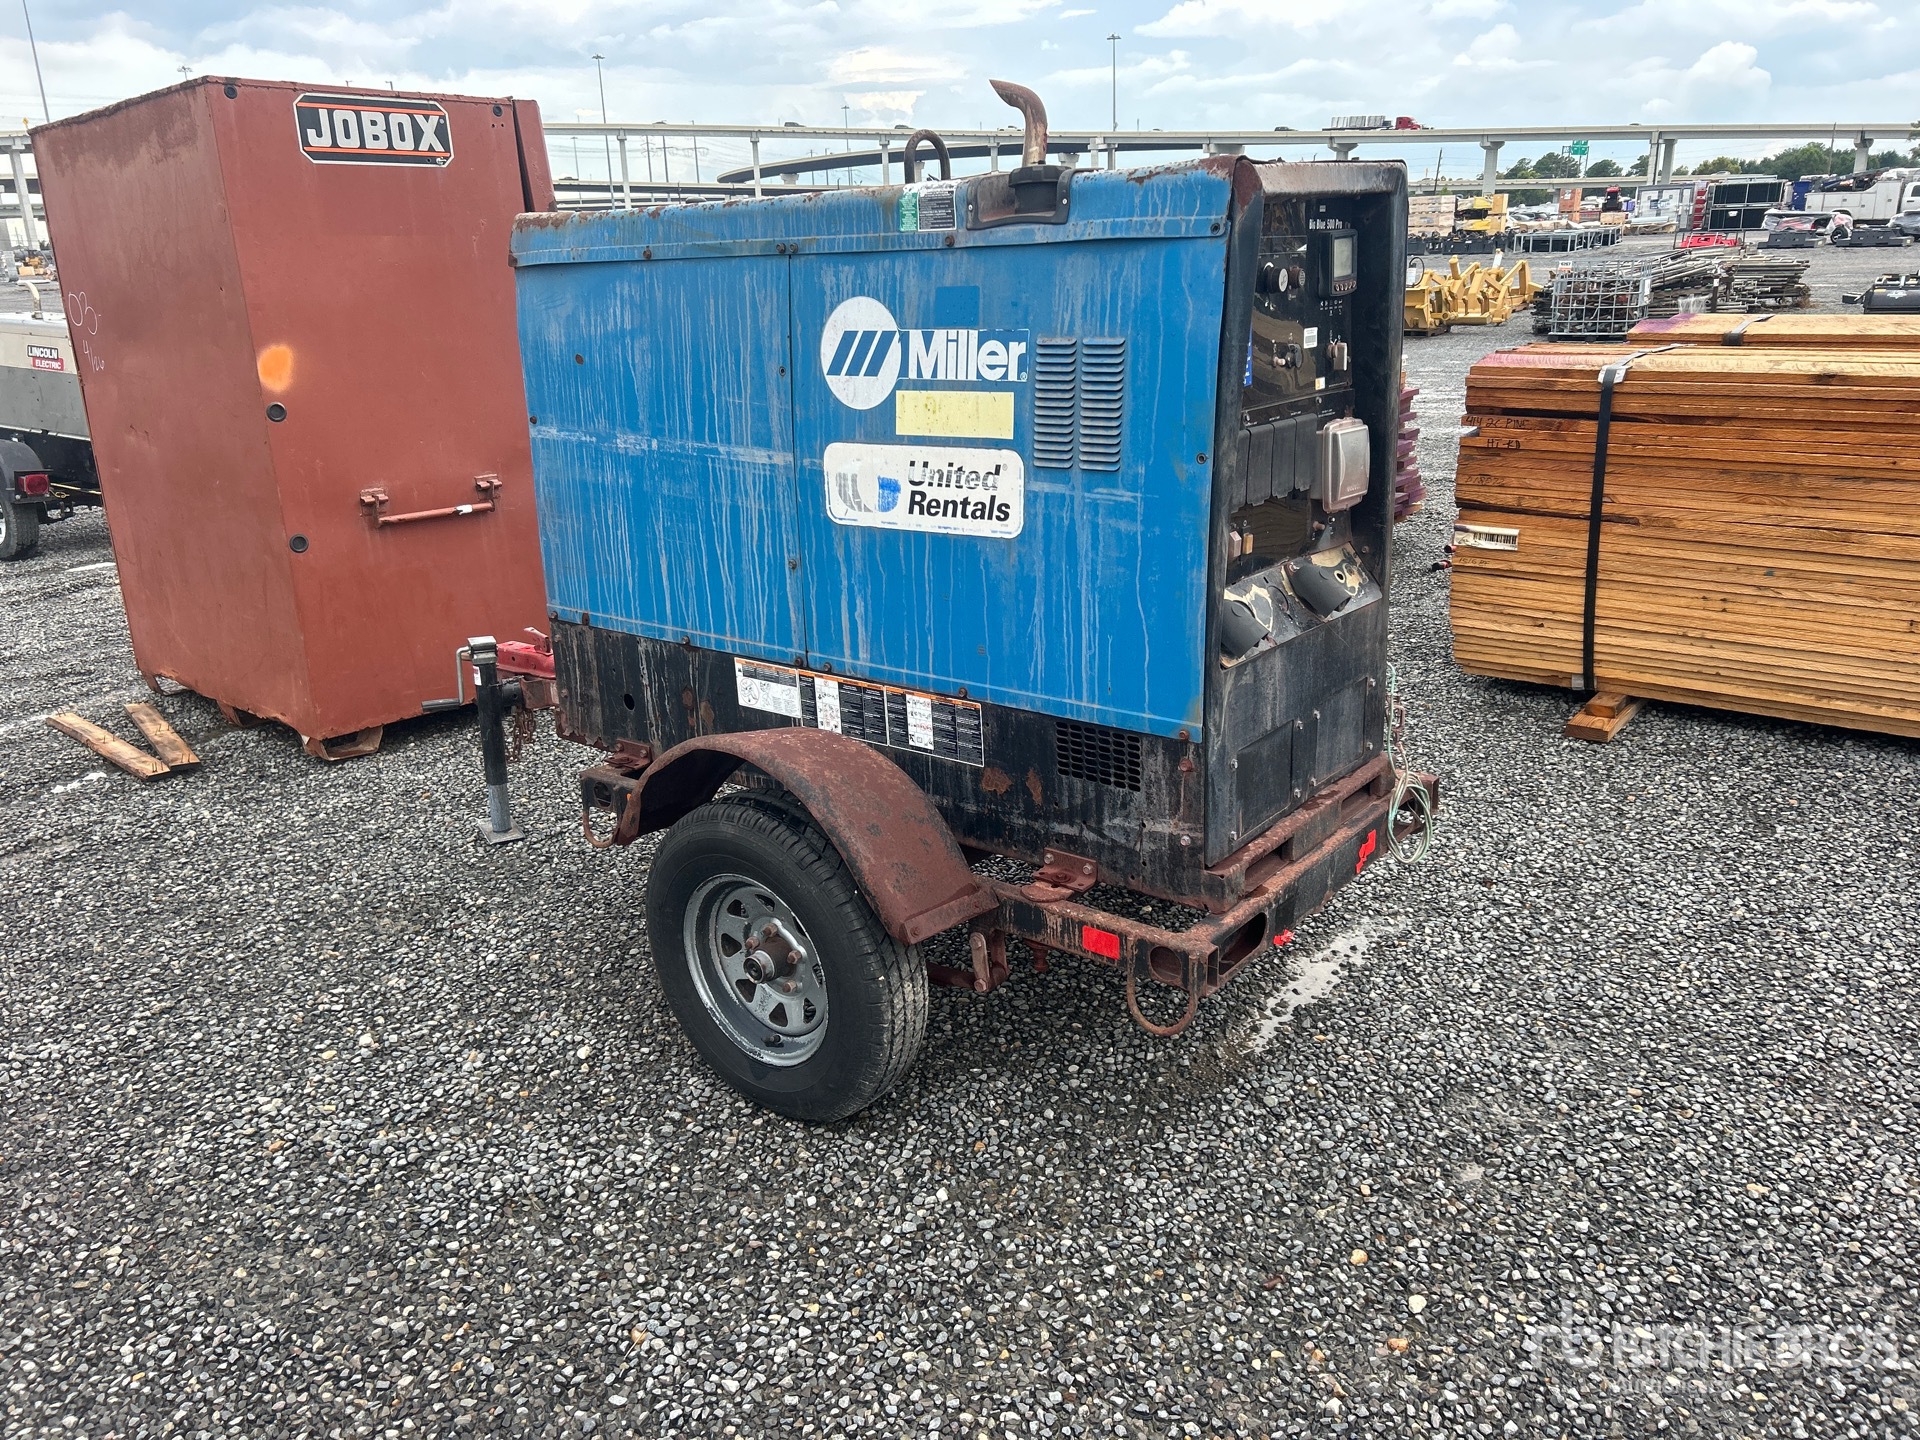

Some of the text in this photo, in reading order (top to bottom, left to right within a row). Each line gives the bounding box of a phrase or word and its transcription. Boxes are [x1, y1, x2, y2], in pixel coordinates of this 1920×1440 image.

[306, 108, 446, 152] JOBOX
[28, 346, 58, 360] LINCOLN
[35, 359, 62, 370] ELECTRIC
[908, 330, 1027, 381] Miller
[907, 460, 1002, 491] United
[907, 489, 1011, 523] Rentals
